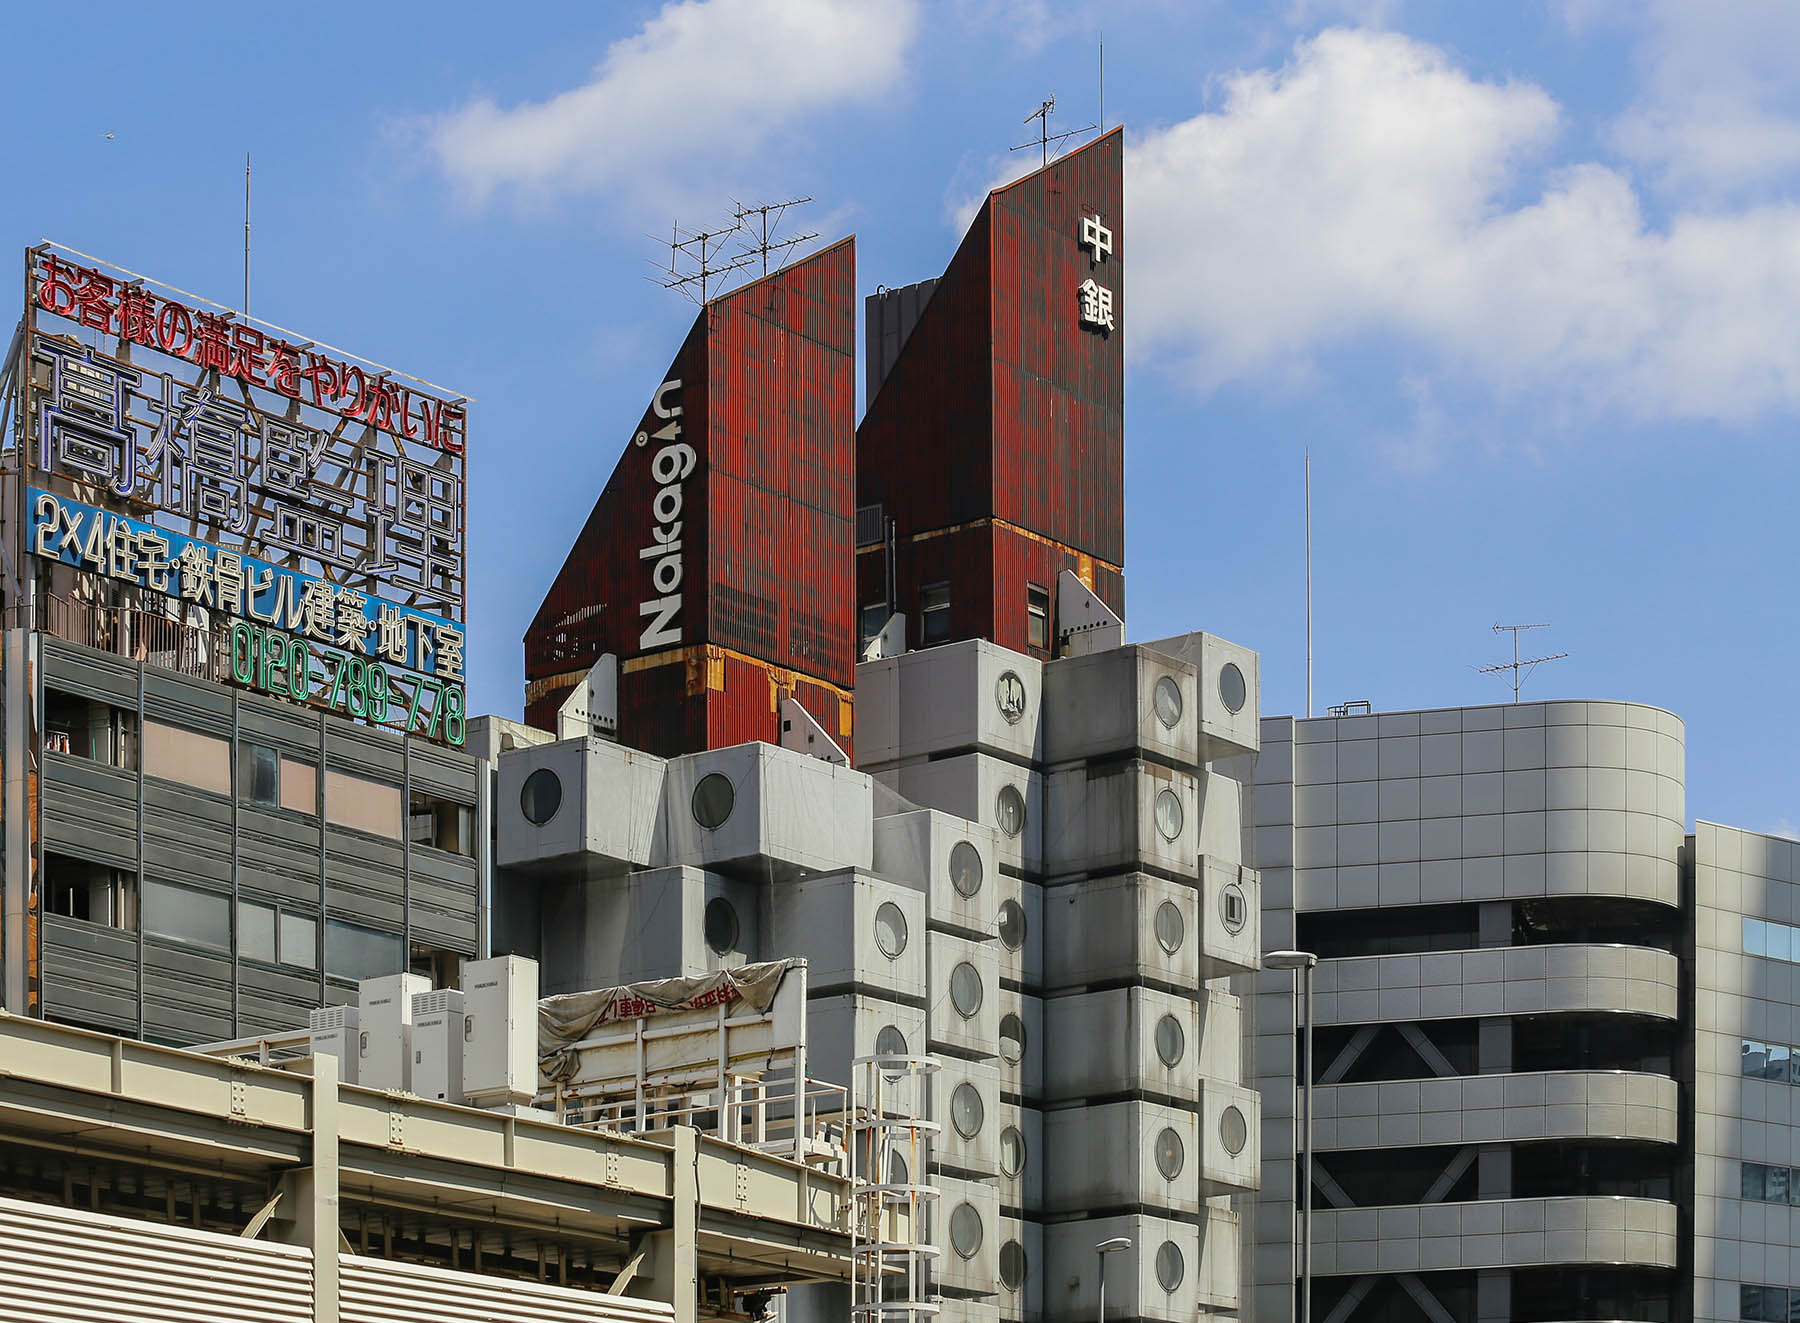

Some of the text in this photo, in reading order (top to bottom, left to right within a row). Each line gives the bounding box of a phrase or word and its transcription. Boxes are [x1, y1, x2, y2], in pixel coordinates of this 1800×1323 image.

[40, 253, 465, 453] お客様の満足をやりがいに
[1080, 214, 1115, 332] 中銀
[636, 378, 697, 650] Nakagin
[231, 621, 465, 746] 0120-789-778
